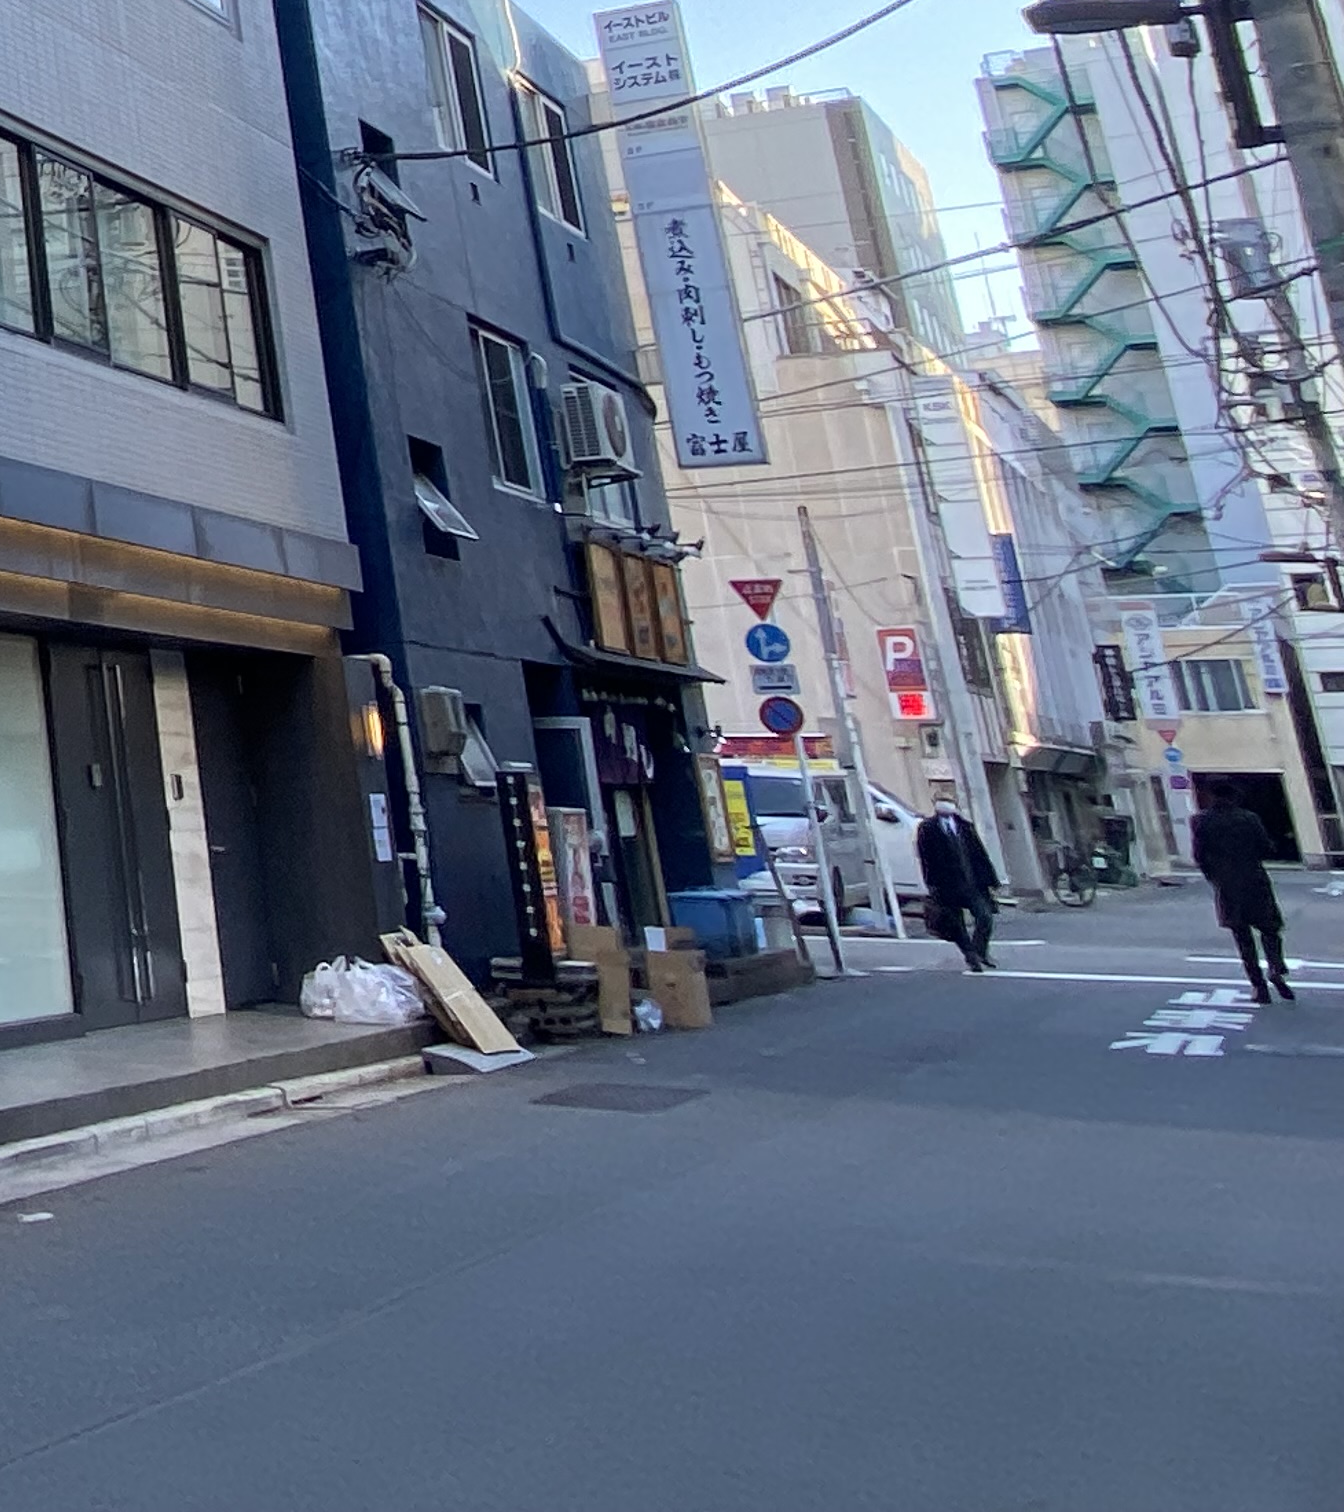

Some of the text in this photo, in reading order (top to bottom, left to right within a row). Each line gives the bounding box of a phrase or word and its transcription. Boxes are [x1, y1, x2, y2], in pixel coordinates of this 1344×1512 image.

[604, 12, 670, 31] イーストビル
[609, 31, 636, 43] EAST
[611, 53, 679, 75] イースト
[686, 432, 753, 457] 富士屋
[886, 636, 914, 671] P
